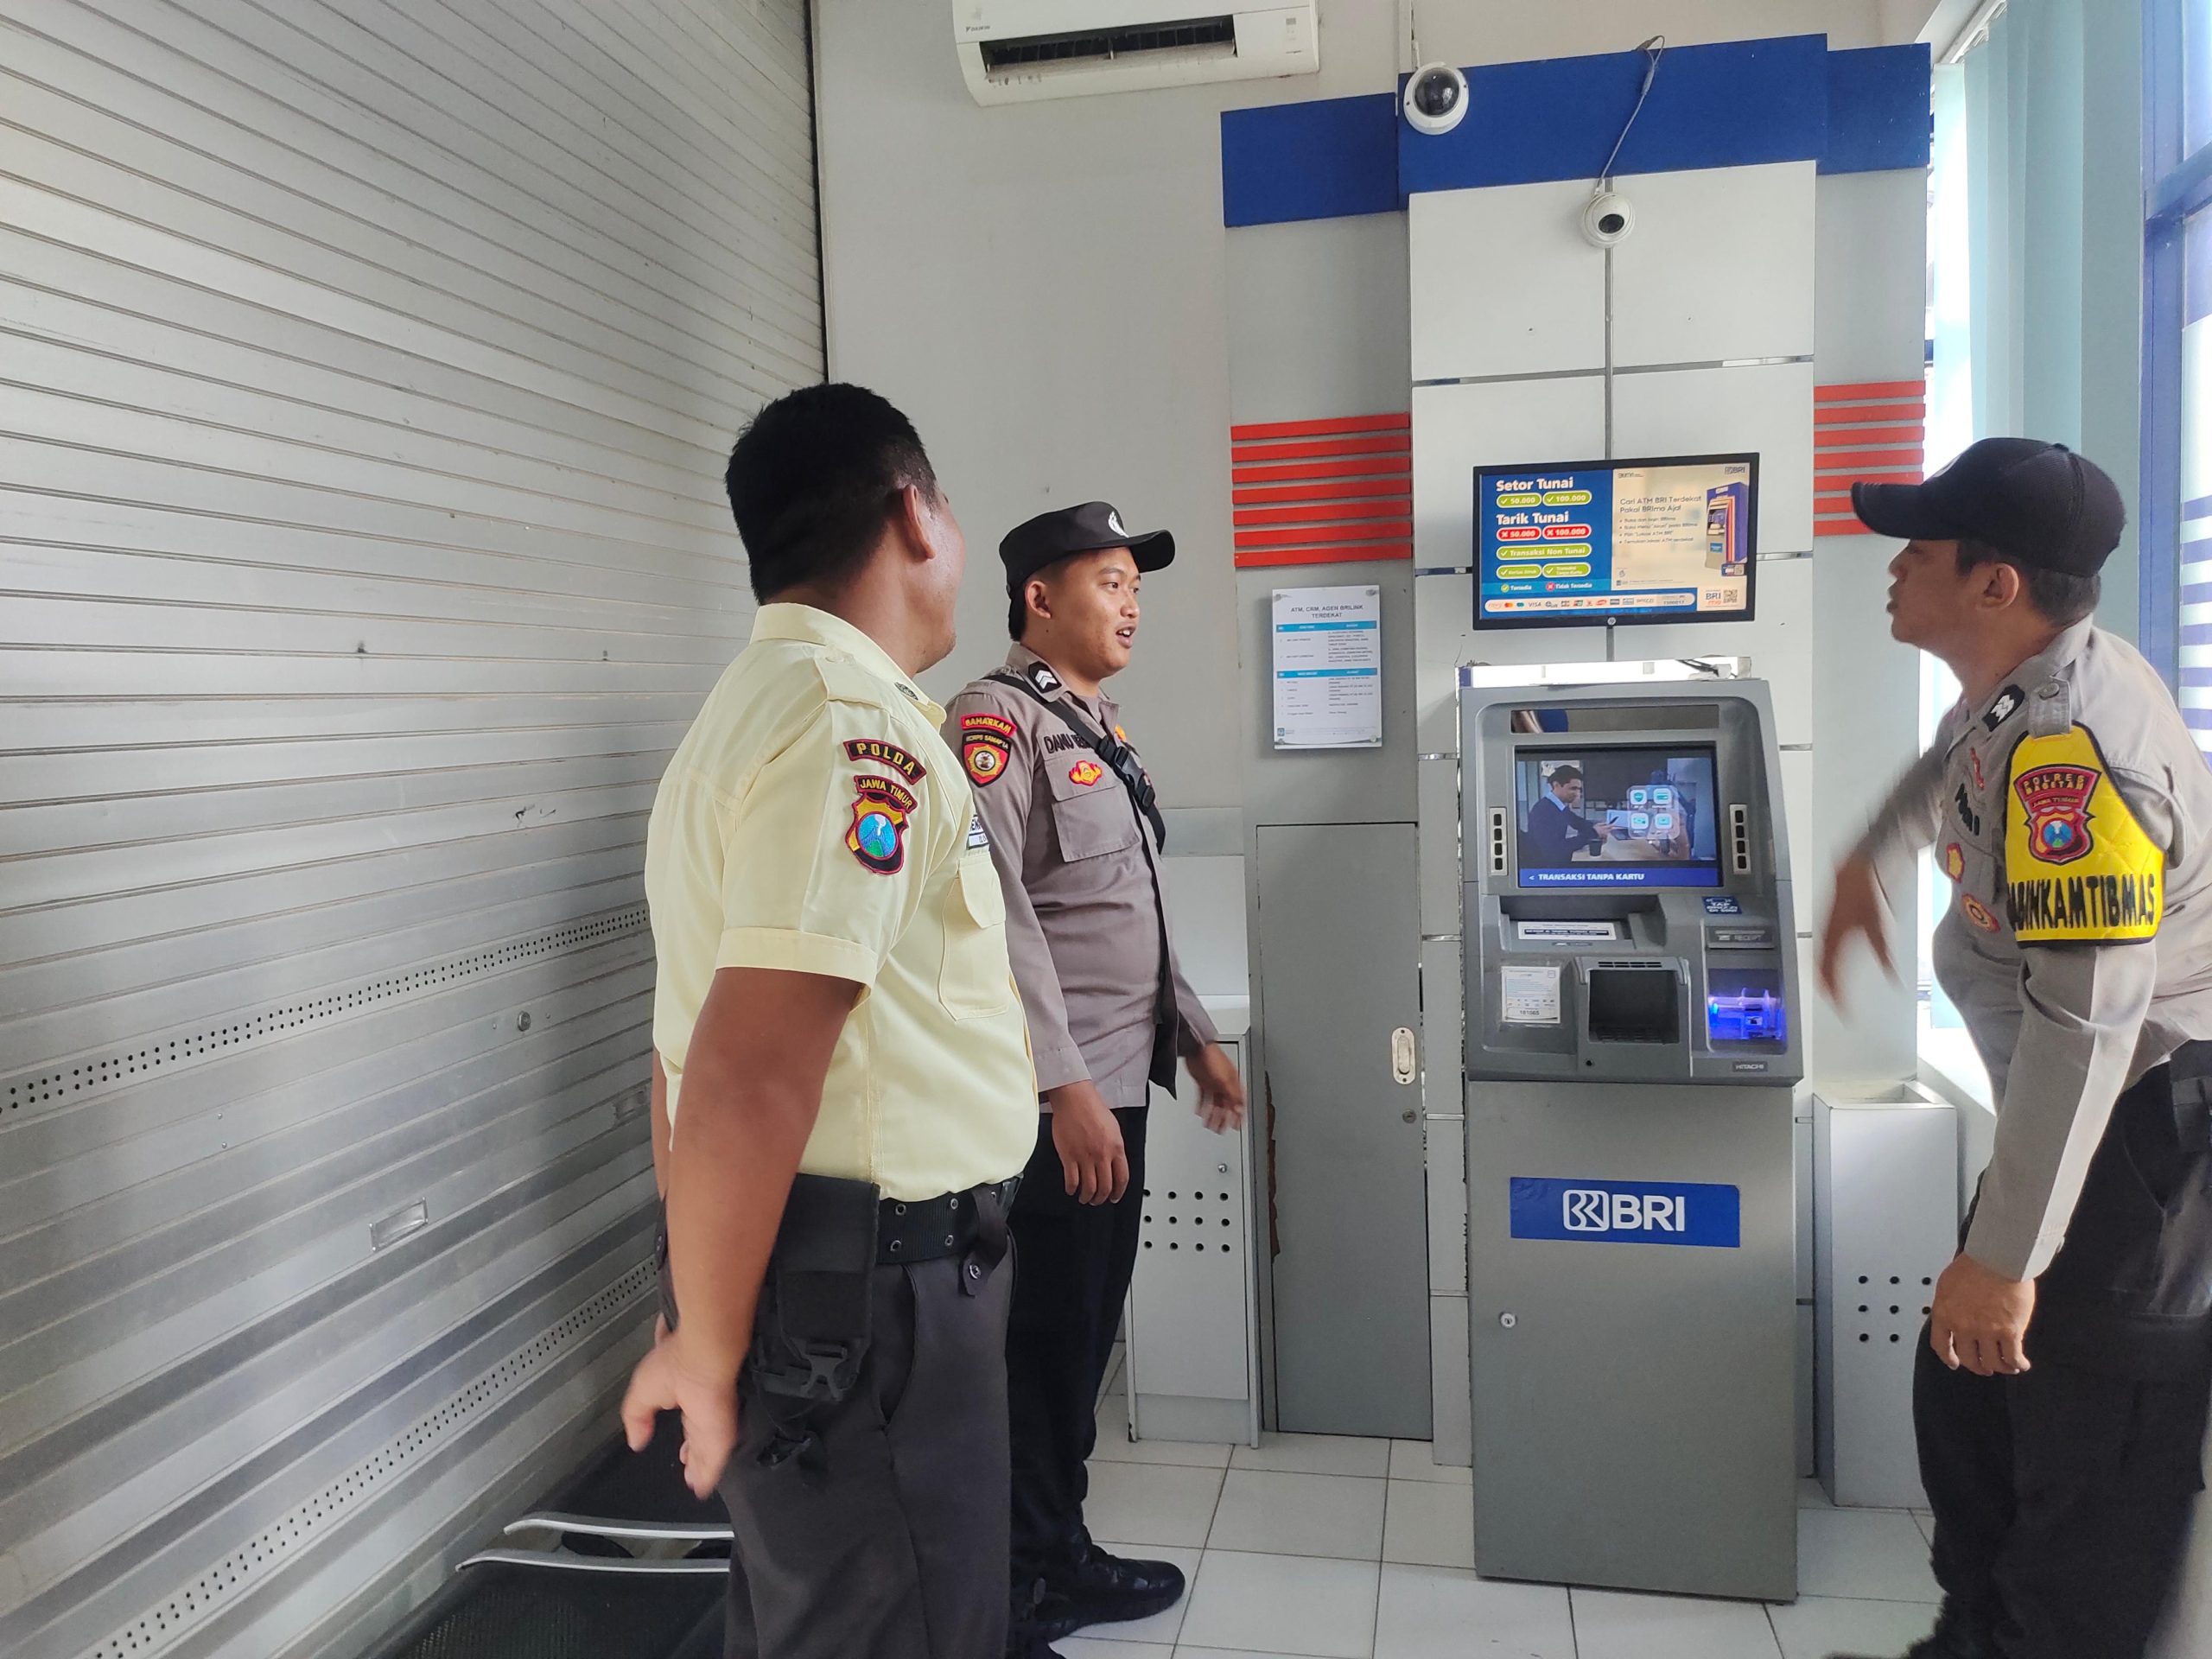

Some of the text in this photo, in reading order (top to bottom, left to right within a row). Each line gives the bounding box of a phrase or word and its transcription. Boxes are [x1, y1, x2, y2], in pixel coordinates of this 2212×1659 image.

[1496, 476, 1573, 492] Setor Tunai
[1496, 511, 1569, 525] Tarik Tunai
[1706, 592, 1721, 601] BRI
[965, 716, 1011, 734] BAHARKAM
[1044, 734, 1074, 754] DANU
[856, 742, 916, 776] POLDA
[2023, 772, 2085, 788] POLRES
[860, 779, 913, 809] JAWA TIMUR
[1611, 1193, 1685, 1232] BRI
